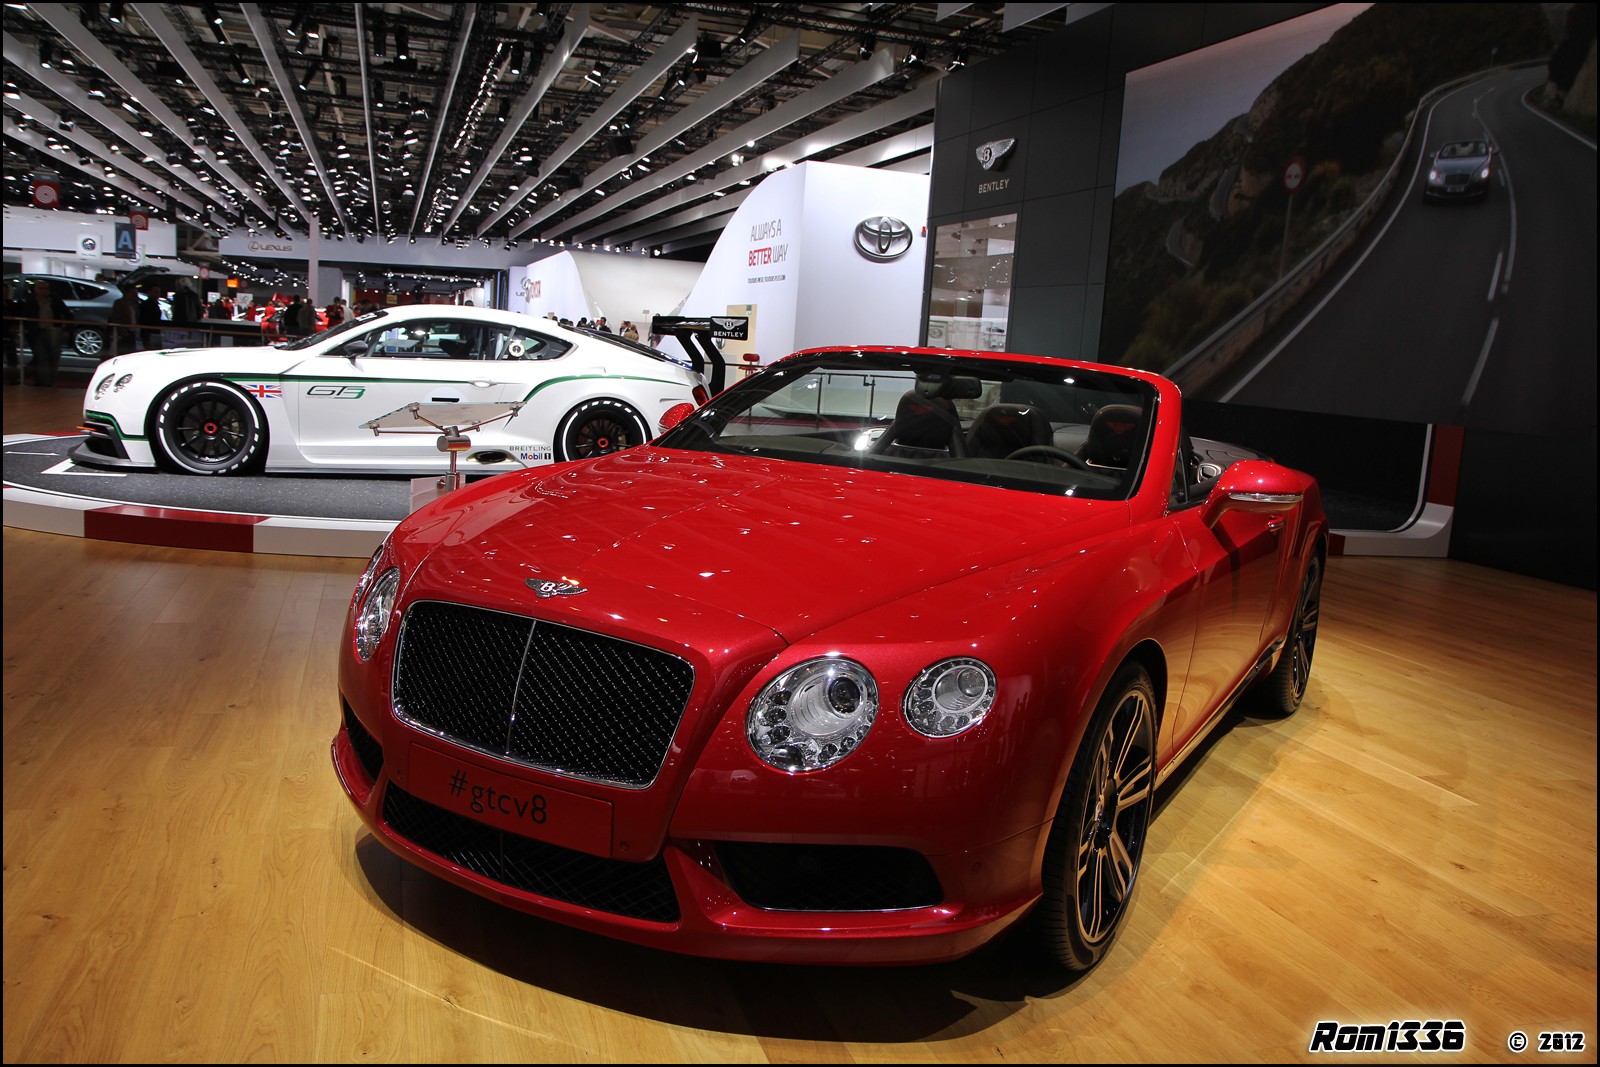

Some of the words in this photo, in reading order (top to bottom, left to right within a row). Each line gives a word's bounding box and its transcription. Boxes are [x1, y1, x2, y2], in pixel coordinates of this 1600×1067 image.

[978, 178, 1010, 194] BENTLEY
[750, 220, 776, 242] ALWAYS
[776, 218, 782, 237] A
[118, 230, 133, 249] A
[260, 243, 293, 252] LEXUS
[748, 246, 772, 267] BETTER
[772, 243, 789, 263] WAY
[713, 330, 744, 338] BENTLEY
[520, 452, 543, 460] Mobil
[544, 452, 552, 460] 1
[540, 582, 556, 593] B
[448, 768, 548, 825] #gtcv8
